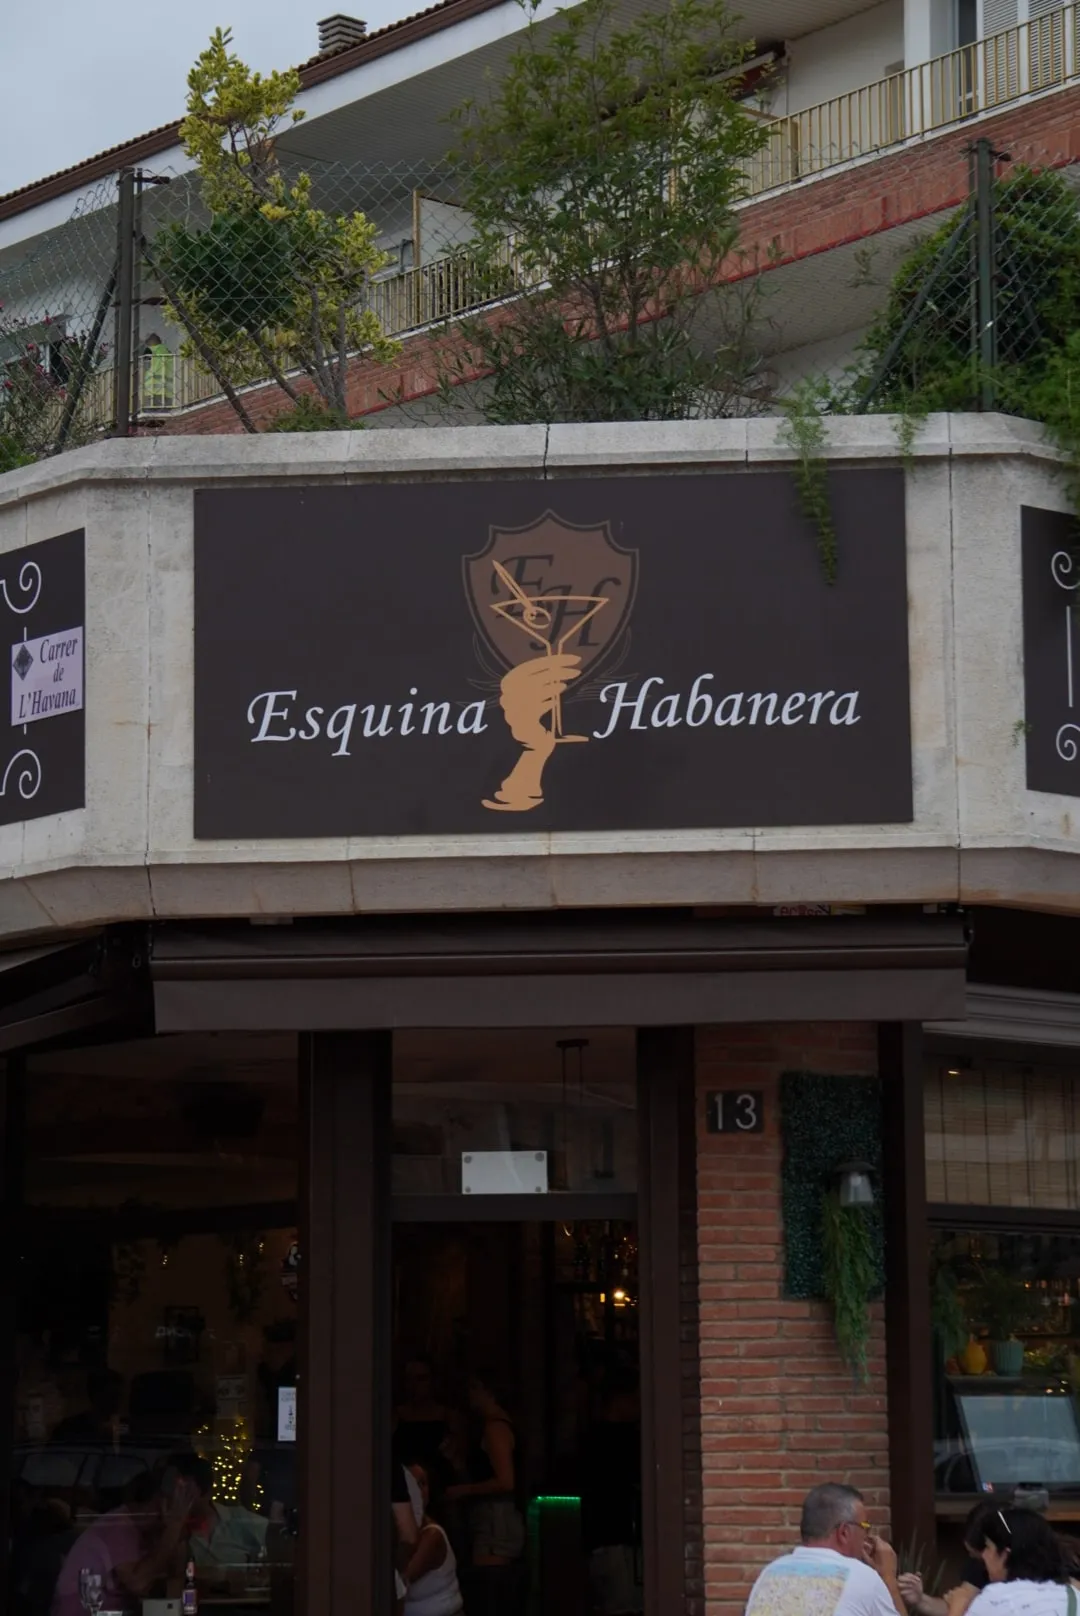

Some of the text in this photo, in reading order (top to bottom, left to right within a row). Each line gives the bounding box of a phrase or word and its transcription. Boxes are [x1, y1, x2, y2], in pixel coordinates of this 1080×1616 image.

[40, 638, 78, 664] Carrer
[53, 662, 65, 683] de
[19, 688, 77, 719] L'Havana
[247, 673, 861, 756] Esquina Habanera
[714, 1092, 757, 1130] 13
